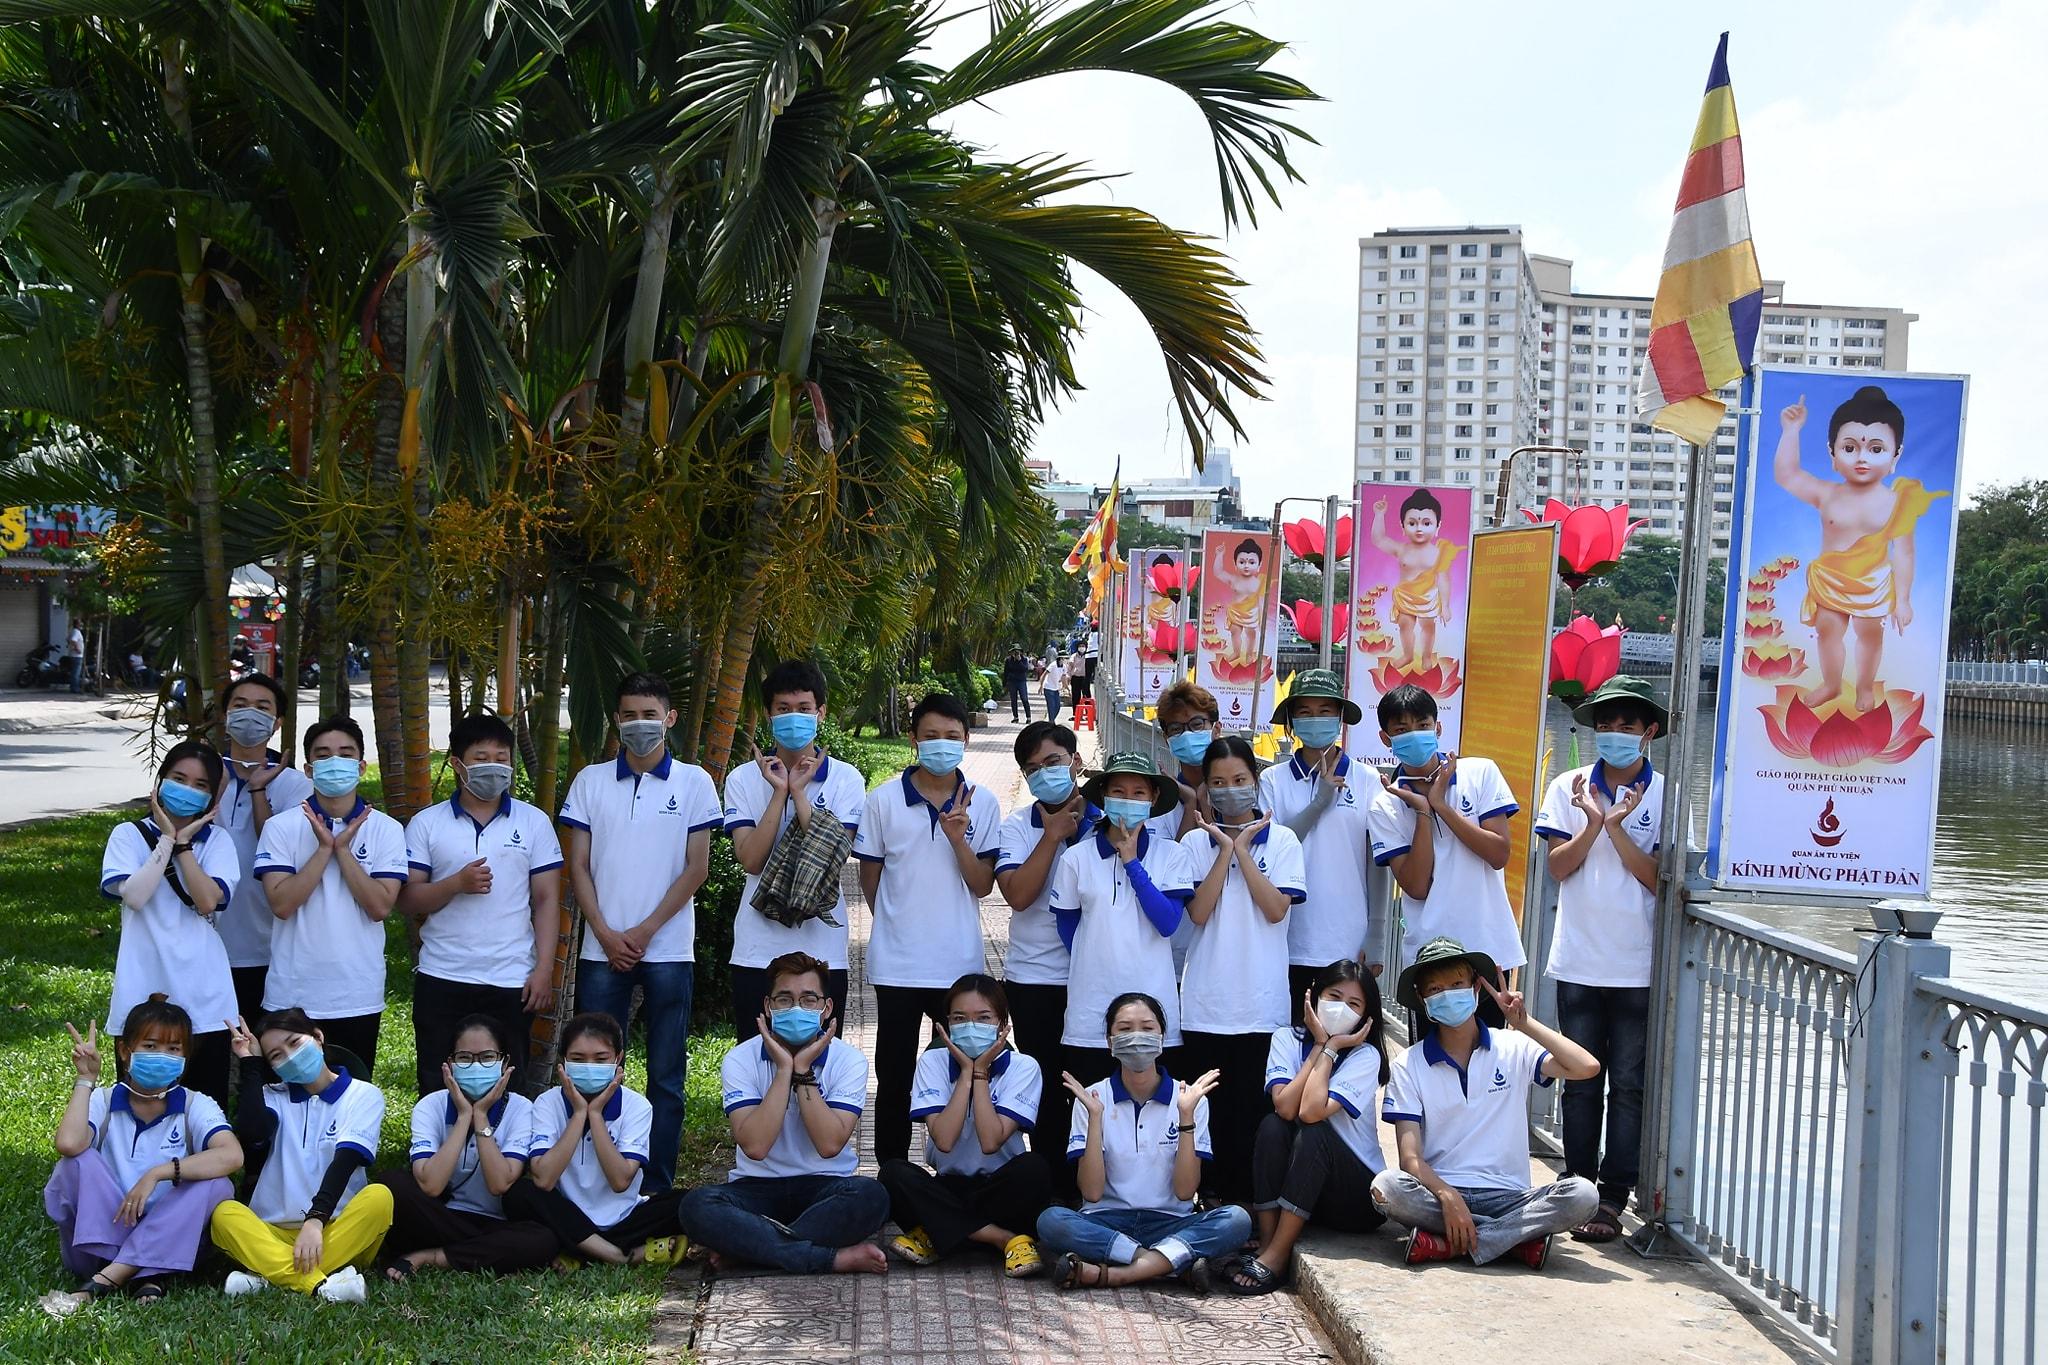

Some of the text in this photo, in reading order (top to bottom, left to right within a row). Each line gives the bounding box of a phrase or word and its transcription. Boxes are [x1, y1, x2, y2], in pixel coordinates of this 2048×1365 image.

[1756, 769, 1906, 785] GIÁO HỘI PHẬT GIÁO VIỆT NAM
[1788, 782, 1874, 796] QUẬN PHÚ NHUẬN
[1792, 850, 1812, 858] QUAN
[1840, 851, 1861, 862] VIỆN
[1731, 859, 1775, 878] KÍNH
[1778, 862, 1832, 881] MỪNG
[1835, 867, 1882, 886] PHẬT
